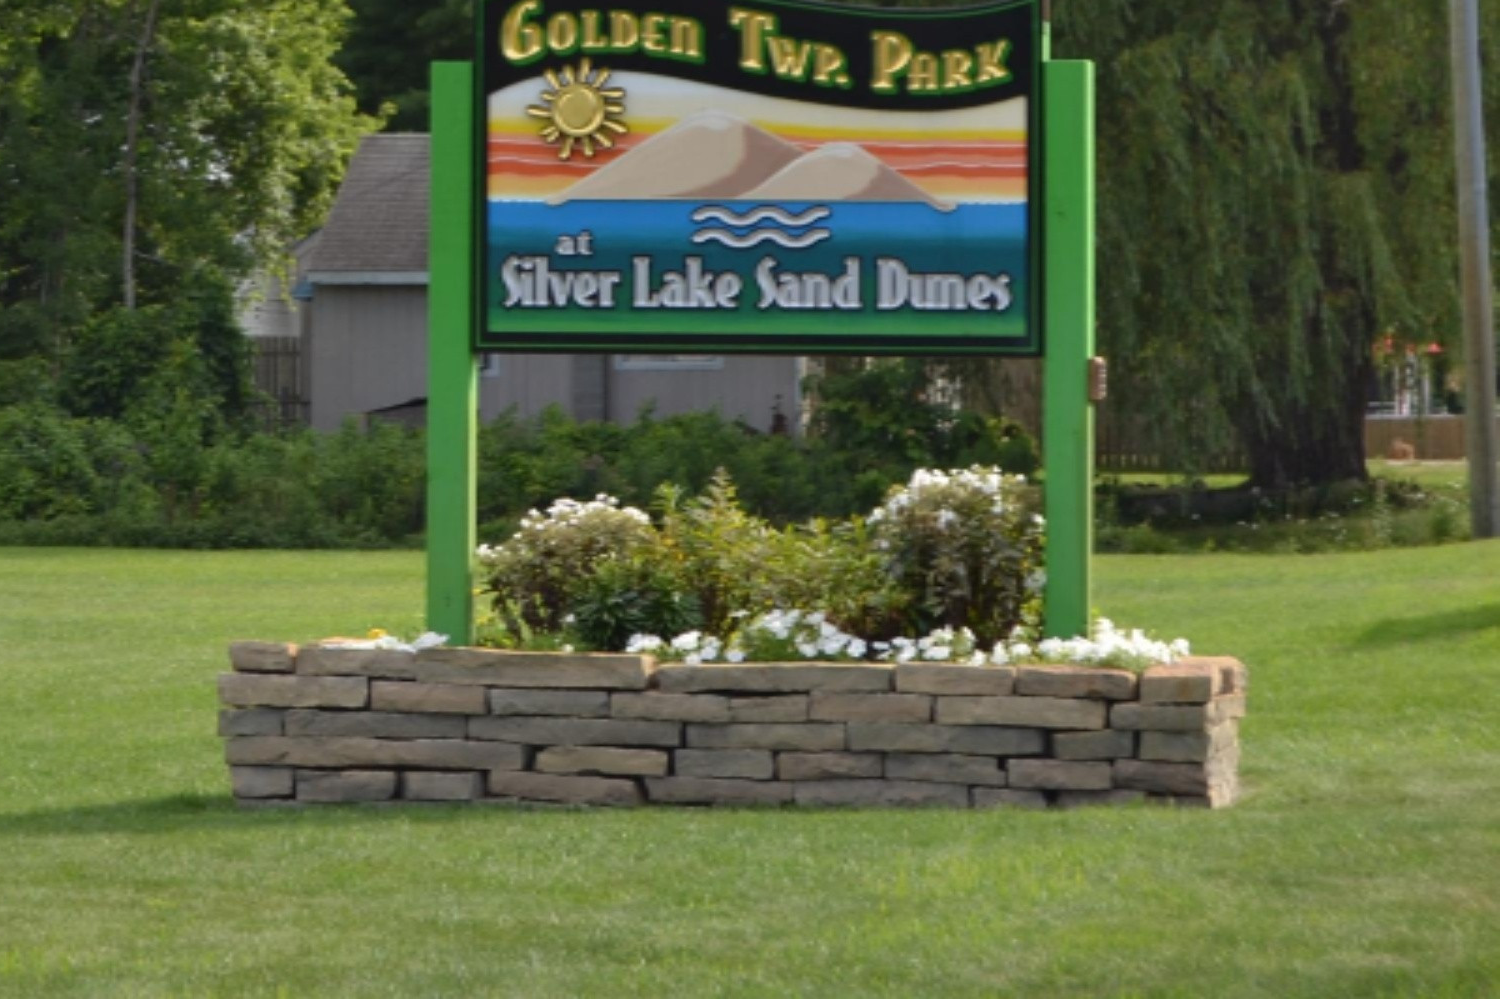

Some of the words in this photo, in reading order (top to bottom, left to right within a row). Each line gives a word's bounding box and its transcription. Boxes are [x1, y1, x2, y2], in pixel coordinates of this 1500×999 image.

[728, 7, 850, 85] TWP.
[869, 30, 1010, 91] PARK
[555, 230, 593, 256] at
[501, 254, 621, 308] Silver
[632, 255, 742, 308] Lake
[756, 255, 863, 309] Sand
[876, 257, 1011, 311] Dunes
